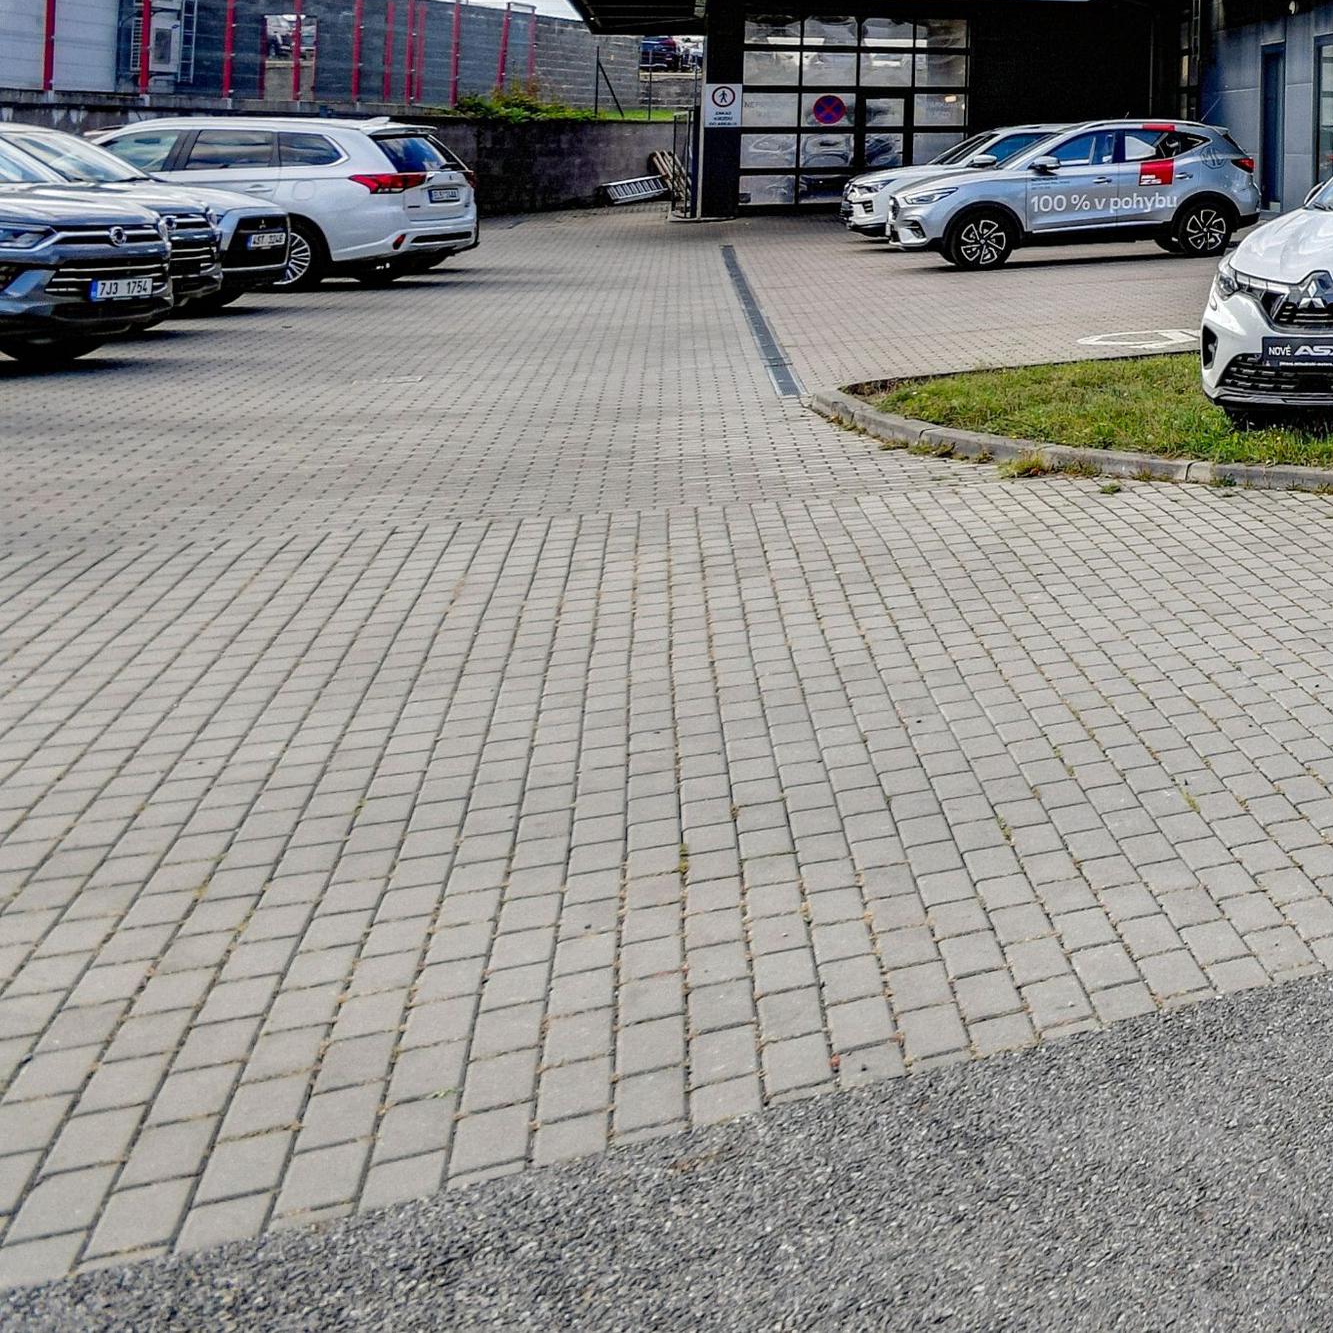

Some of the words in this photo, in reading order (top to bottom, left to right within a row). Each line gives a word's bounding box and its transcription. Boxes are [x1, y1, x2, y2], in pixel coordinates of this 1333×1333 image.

[1030, 194, 1067, 213] 100
[1070, 194, 1091, 211] %
[1093, 197, 1105, 210] v
[1109, 192, 1178, 214] pohybu
[100, 280, 118, 296] 7J3
[126, 278, 149, 293] 1754
[1268, 344, 1292, 356] NOVÉ
